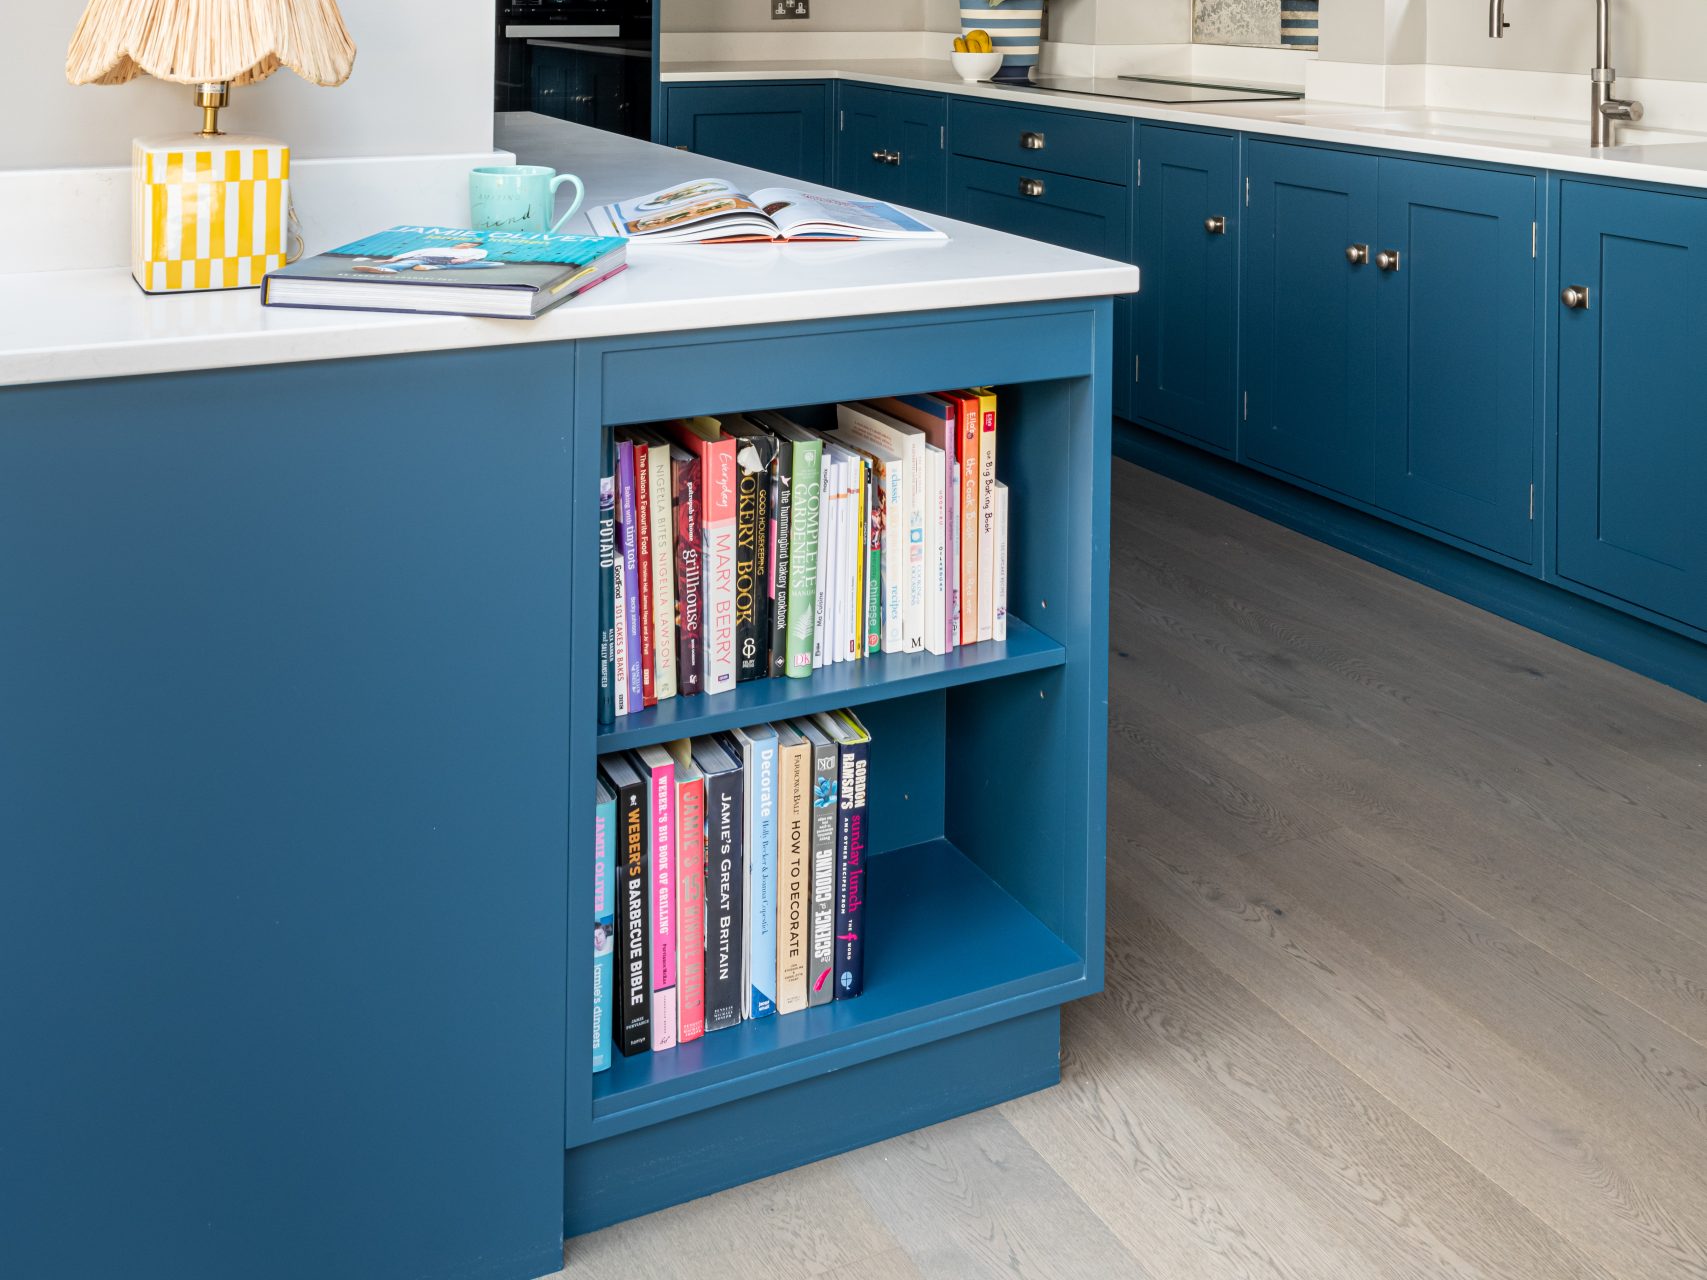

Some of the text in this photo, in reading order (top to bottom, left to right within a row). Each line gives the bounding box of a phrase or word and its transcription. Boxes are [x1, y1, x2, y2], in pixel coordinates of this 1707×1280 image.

[395, 226, 605, 242] JAMIE OLIVER
[968, 412, 976, 434] Ella's
[640, 469, 648, 500] Nation's
[655, 464, 666, 513] NIGELLA
[715, 452, 733, 508] Everyday
[891, 474, 901, 503] classic
[983, 462, 993, 477] Big
[687, 481, 696, 515] gastropub
[965, 457, 975, 540] the Cook Book
[983, 479, 994, 510] Baking
[600, 519, 614, 568] POTATO
[625, 526, 635, 548] tiny
[657, 517, 667, 548] BITES
[757, 489, 767, 576] GOOD HOUSEKEEPING
[791, 483, 808, 589] GARDENER'S
[803, 482, 820, 589] COMPLETE
[984, 512, 993, 534] Book
[627, 548, 636, 570] tots
[736, 470, 756, 626] OKERY BOOK
[776, 490, 791, 630] the hummingbird bakery cookbook
[659, 552, 669, 606] NIGELLA
[683, 549, 699, 631] grillhouse
[716, 534, 732, 665] MARY BERRY
[869, 579, 877, 626] chinese
[890, 585, 900, 620] recipes
[616, 621, 624, 646] CAKES
[660, 613, 671, 670] LAWSON
[911, 637, 922, 648] M
[617, 657, 625, 682] BAKES
[794, 652, 811, 668] DK
[760, 749, 774, 817] Decorate
[840, 752, 856, 810] RAMSAY'S
[854, 759, 868, 809] GORDON
[658, 825, 669, 843] BIG
[759, 820, 770, 839] Holly
[791, 820, 802, 854] HOW
[594, 816, 605, 913] JAMIE OLIVER
[658, 845, 669, 871] BOOK
[659, 872, 669, 885] OF
[790, 858, 801, 878] TO
[815, 850, 833, 902] COOKING
[847, 815, 864, 913] sunday lunch
[627, 807, 643, 1006] WEBER'S BARBECUE BIBLE
[682, 792, 701, 1010] JAMIE'S 15 MINUTE MEALS
[718, 792, 732, 980] JAMIE'S GREAT BRITAIN
[761, 873, 769, 899] Joanna
[659, 887, 669, 934] GRILLING
[760, 900, 769, 936] Copestick
[788, 882, 801, 958] DECORATE
[814, 910, 832, 958] SCIENCE
[836, 931, 858, 942] f
[592, 963, 604, 1049] jamie's dinners
